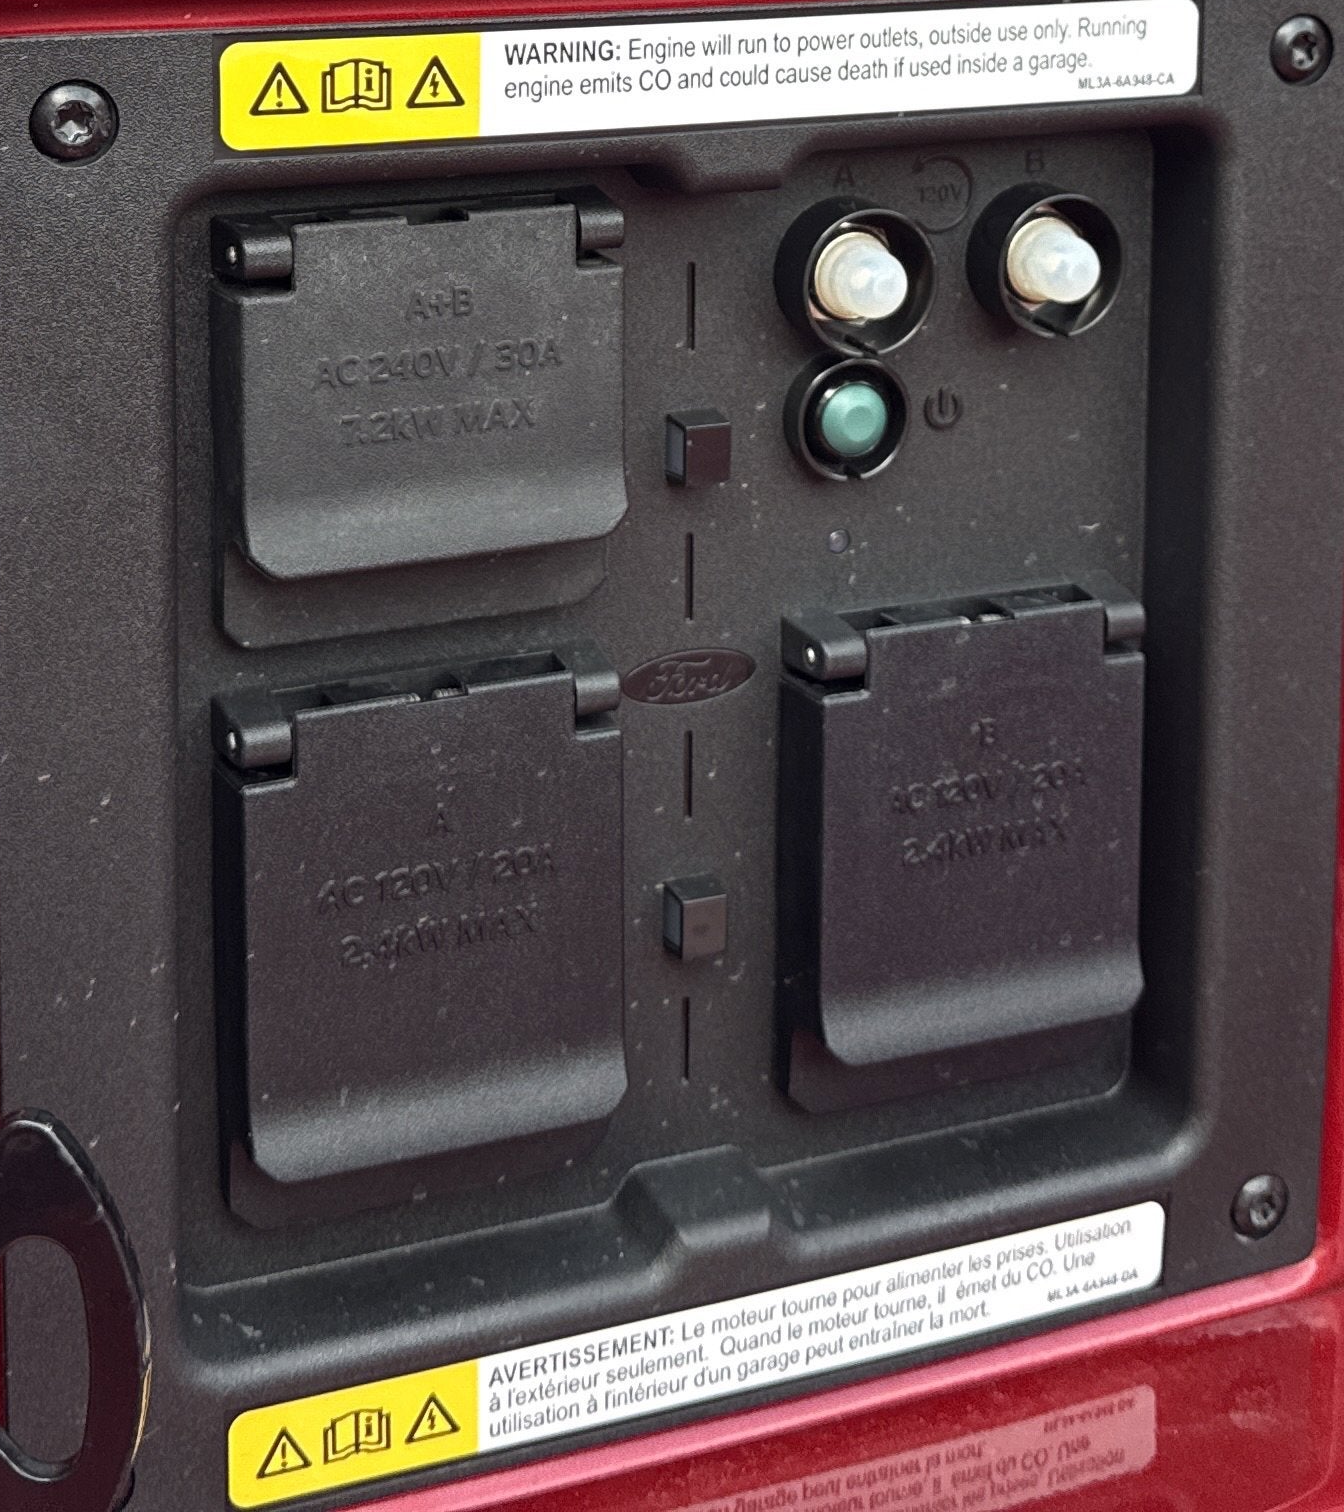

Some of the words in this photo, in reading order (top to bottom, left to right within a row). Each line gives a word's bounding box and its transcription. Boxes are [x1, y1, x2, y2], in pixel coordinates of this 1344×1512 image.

[504, 39, 621, 66] WARNING:
[628, 37, 696, 65] Engine
[702, 34, 732, 56] will
[738, 38, 767, 55] run
[773, 33, 791, 53] to
[797, 33, 855, 57] power
[860, 26, 923, 49] outlets,
[929, 22, 992, 46] outside
[997, 26, 1028, 42] use
[1033, 18, 1072, 43] only.
[1077, 15, 1147, 40] Running
[504, 74, 573, 103] engine
[579, 71, 632, 95] emits
[638, 68, 672, 92] CO
[678, 67, 713, 90] and
[720, 64, 769, 88] could
[775, 65, 831, 84] cause
[838, 59, 888, 81] death
[893, 56, 905, 78] if
[909, 54, 952, 77] used
[956, 51, 1007, 76] inside
[1012, 55, 1023, 72] a
[1028, 51, 1093, 76] garage.
[452, 396, 537, 435] MAX
[488, 1325, 674, 1388] AVERTISSEMENT:
[681, 1321, 705, 1342] Le
[711, 1303, 777, 1336] moteur
[782, 1290, 837, 1319] tourne
[842, 1279, 882, 1307] pour
[886, 1258, 964, 1293] alimenter
[968, 1253, 992, 1273] les
[997, 1240, 1049, 1268] prises.
[1055, 1219, 1132, 1252] Utilisation
[489, 1390, 501, 1413] à
[507, 1370, 600, 1410] l'extérieur
[606, 1344, 709, 1385] seulement.
[720, 1325, 782, 1358] Quand
[787, 1321, 803, 1342] le
[808, 1308, 869, 1337] moteur
[874, 1293, 932, 1320] tourne,
[937, 1285, 946, 1305] il
[956, 1275, 997, 1300] émet
[1001, 1267, 1022, 1289] du
[1026, 1257, 1057, 1282] CO.
[1063, 1250, 1096, 1272] Une
[489, 1400, 580, 1437] utilisation
[586, 1394, 598, 1415] à
[605, 1374, 688, 1411] l'intérieur
[694, 1363, 731, 1389] d'un
[737, 1347, 800, 1382] garage
[805, 1337, 844, 1366] peut
[849, 1316, 925, 1351] entraîner
[929, 1311, 944, 1331] la
[949, 1299, 992, 1326] mort.
